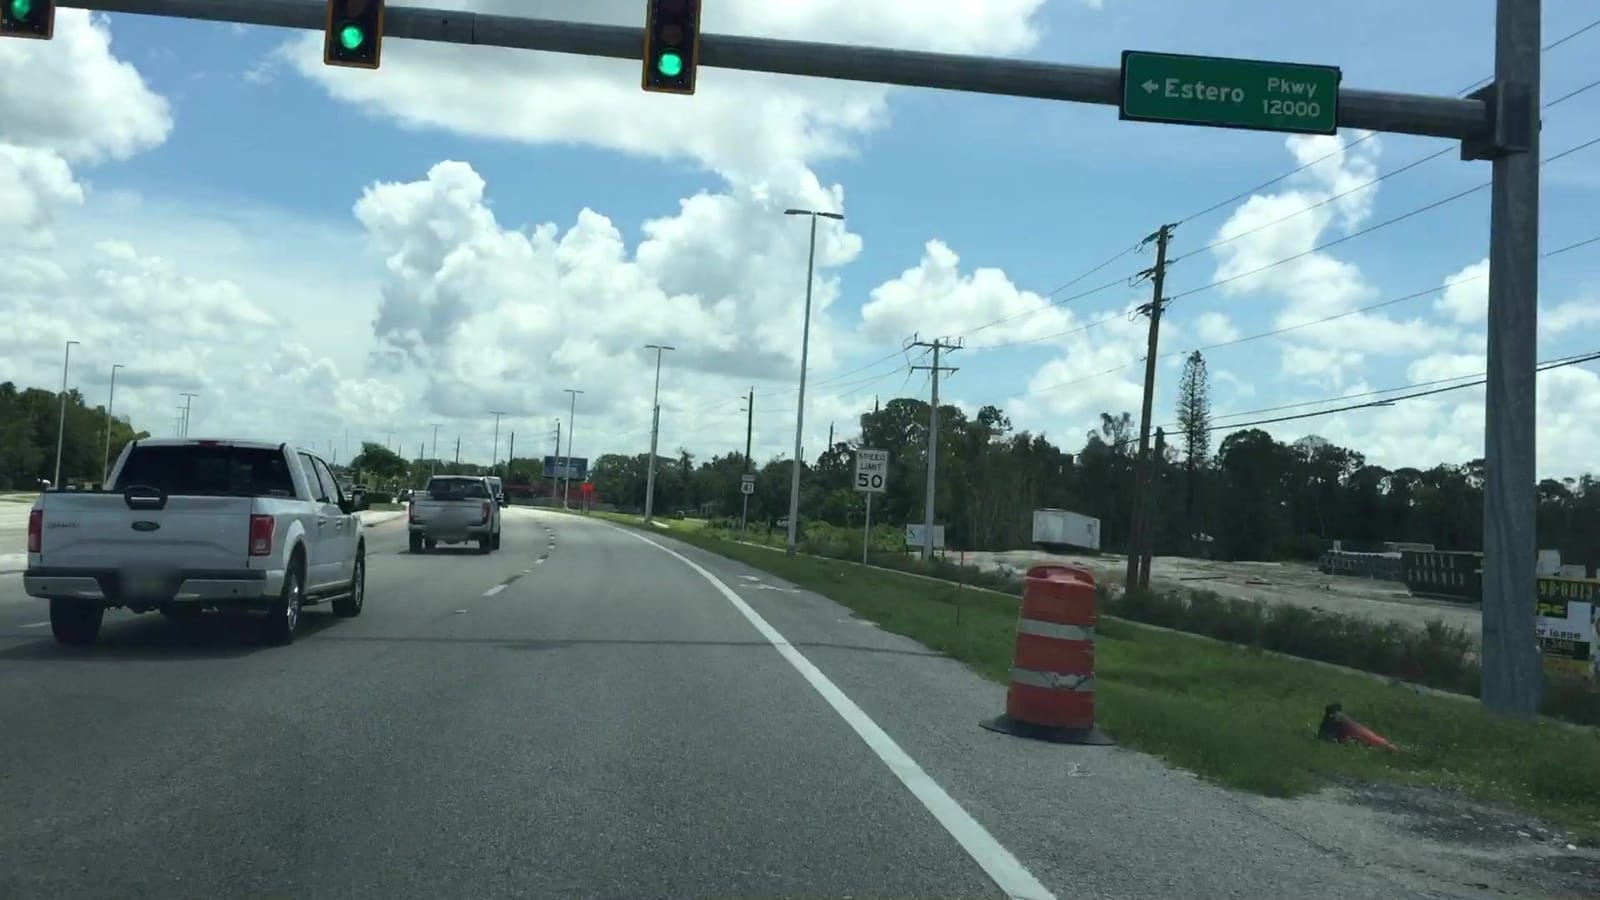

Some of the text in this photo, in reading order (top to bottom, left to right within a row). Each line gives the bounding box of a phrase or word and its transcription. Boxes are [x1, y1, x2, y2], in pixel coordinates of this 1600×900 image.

[1164, 77, 1318, 103] Estero Pkwy
[1263, 99, 1321, 118] 12000
[858, 452, 886, 462] SPEED
[859, 462, 882, 471] LIMIT
[858, 472, 882, 489] 50
